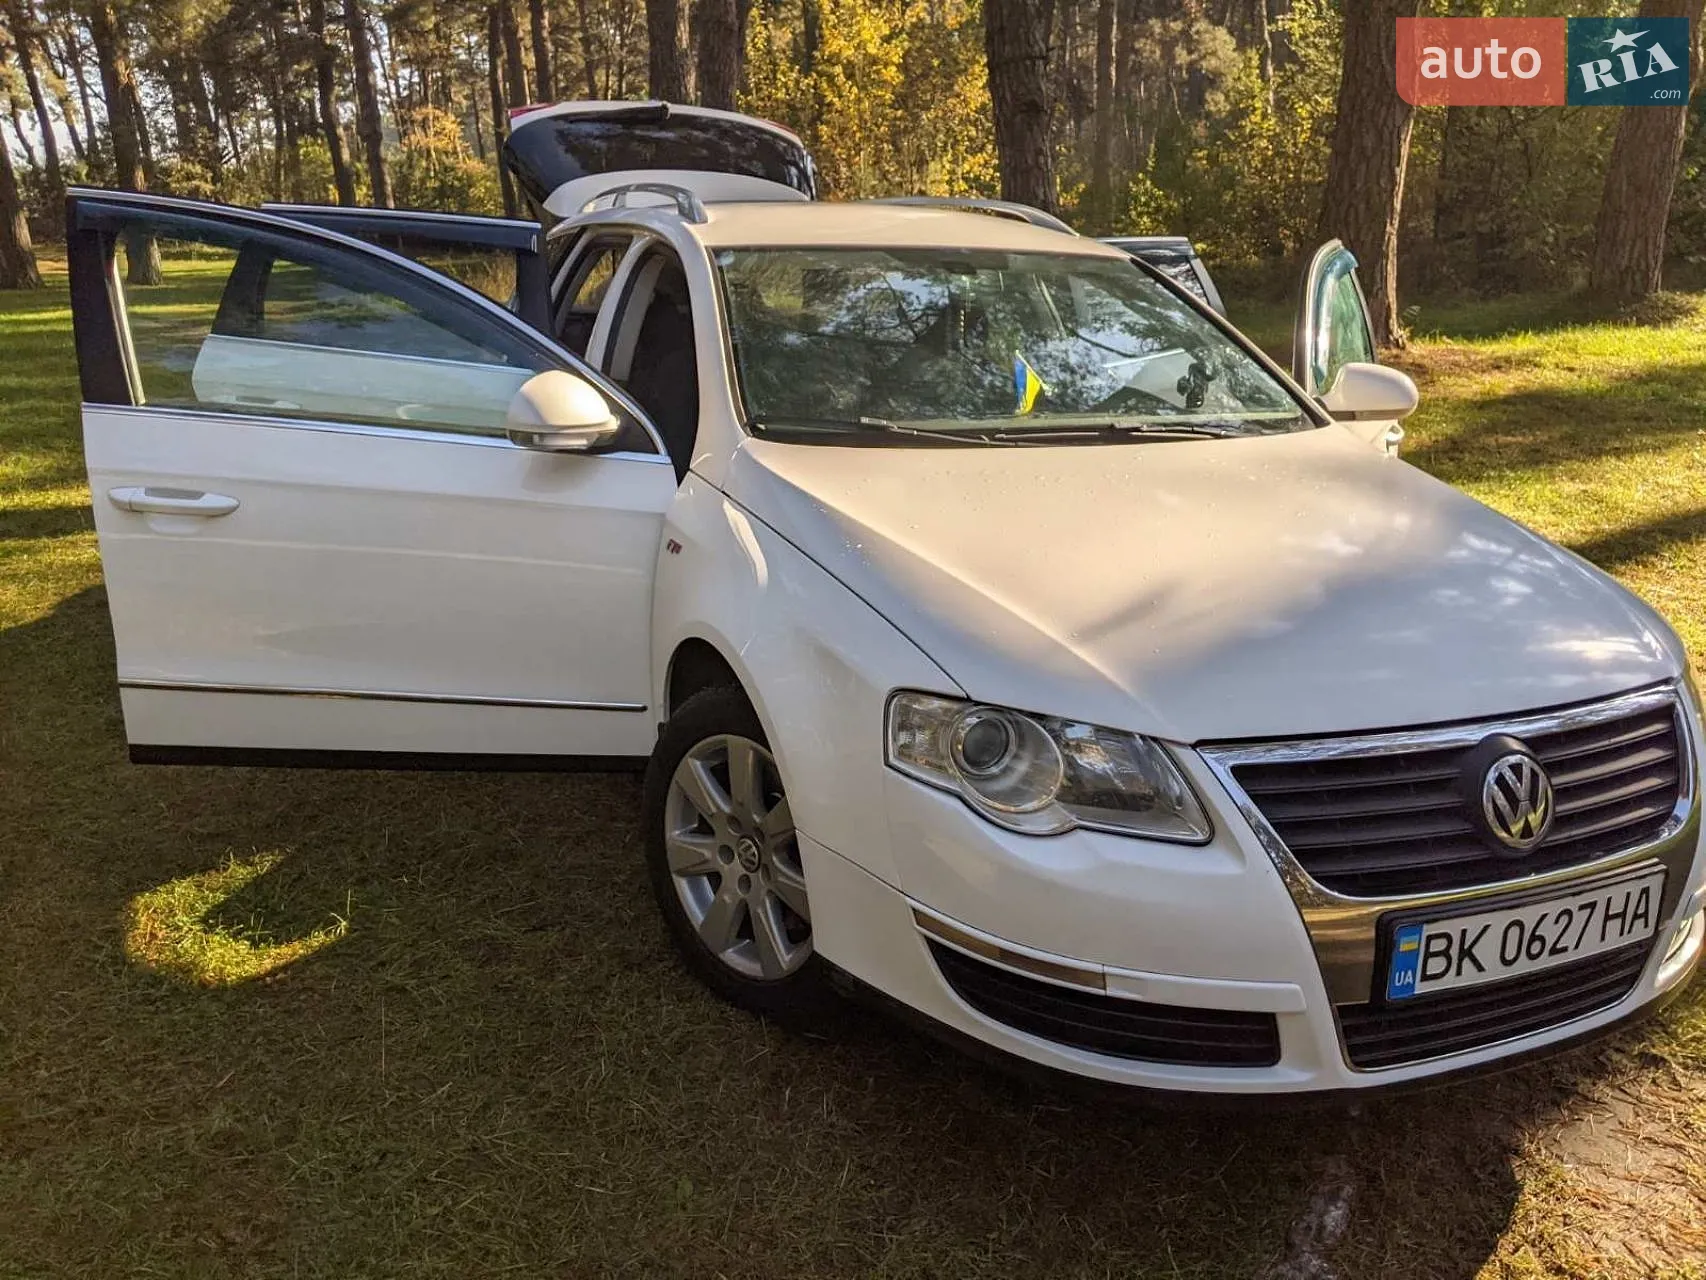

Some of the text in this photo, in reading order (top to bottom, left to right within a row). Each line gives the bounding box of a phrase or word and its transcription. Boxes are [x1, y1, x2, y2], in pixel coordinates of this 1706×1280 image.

[1420, 886, 1650, 983] BK 0627 HA
[1395, 971, 1414, 987] UA
